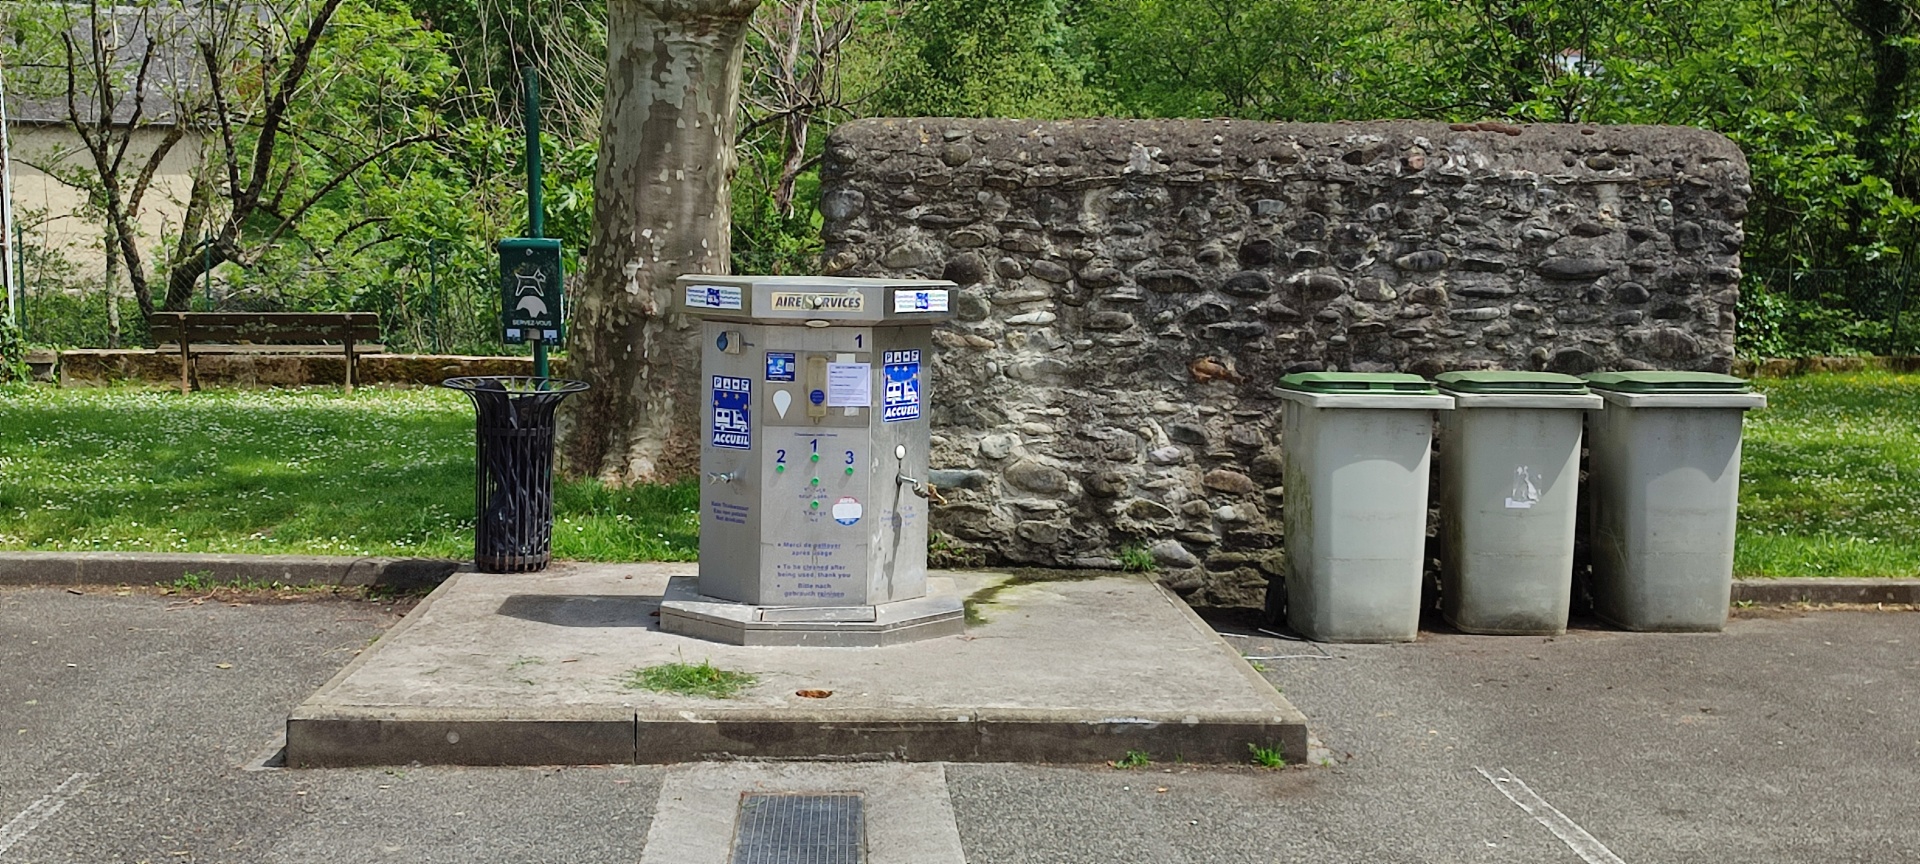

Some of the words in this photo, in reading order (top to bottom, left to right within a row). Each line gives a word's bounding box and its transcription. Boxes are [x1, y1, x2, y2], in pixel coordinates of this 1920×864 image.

[775, 293, 861, 310] AIRESRVICES
[512, 319, 552, 327] SERVEZ-VOUS
[855, 334, 862, 348] 1
[885, 405, 919, 418] ACCUEIL
[714, 433, 749, 446] ACCUEIL
[810, 438, 818, 452] 1
[776, 449, 786, 463] 2
[845, 450, 854, 464] 3
